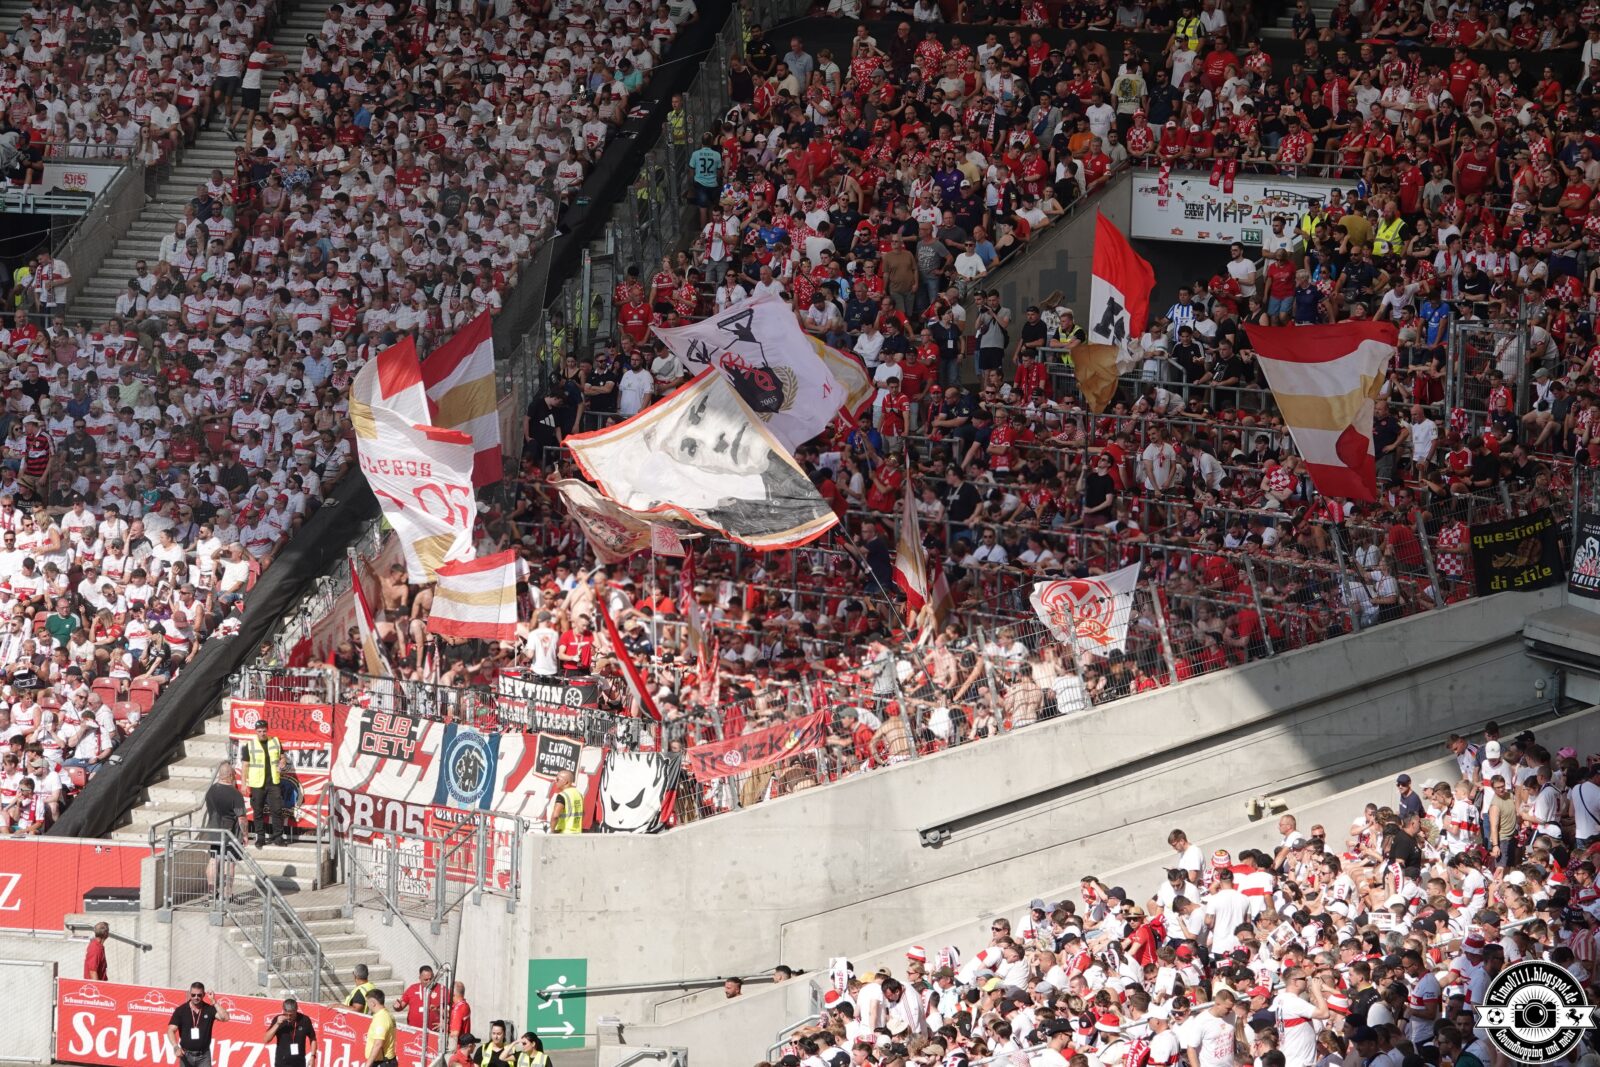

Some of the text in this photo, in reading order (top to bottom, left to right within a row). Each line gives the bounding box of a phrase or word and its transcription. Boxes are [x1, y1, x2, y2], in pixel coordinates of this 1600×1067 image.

[699, 158, 715, 174] 32
[1473, 518, 1552, 549] questione
[1490, 565, 1553, 590] di stile
[499, 674, 563, 704] SEKTION
[372, 712, 412, 737] SUB
[361, 732, 416, 759] CIETY
[548, 741, 573, 757] CURVA
[539, 753, 576, 771] PARADISO
